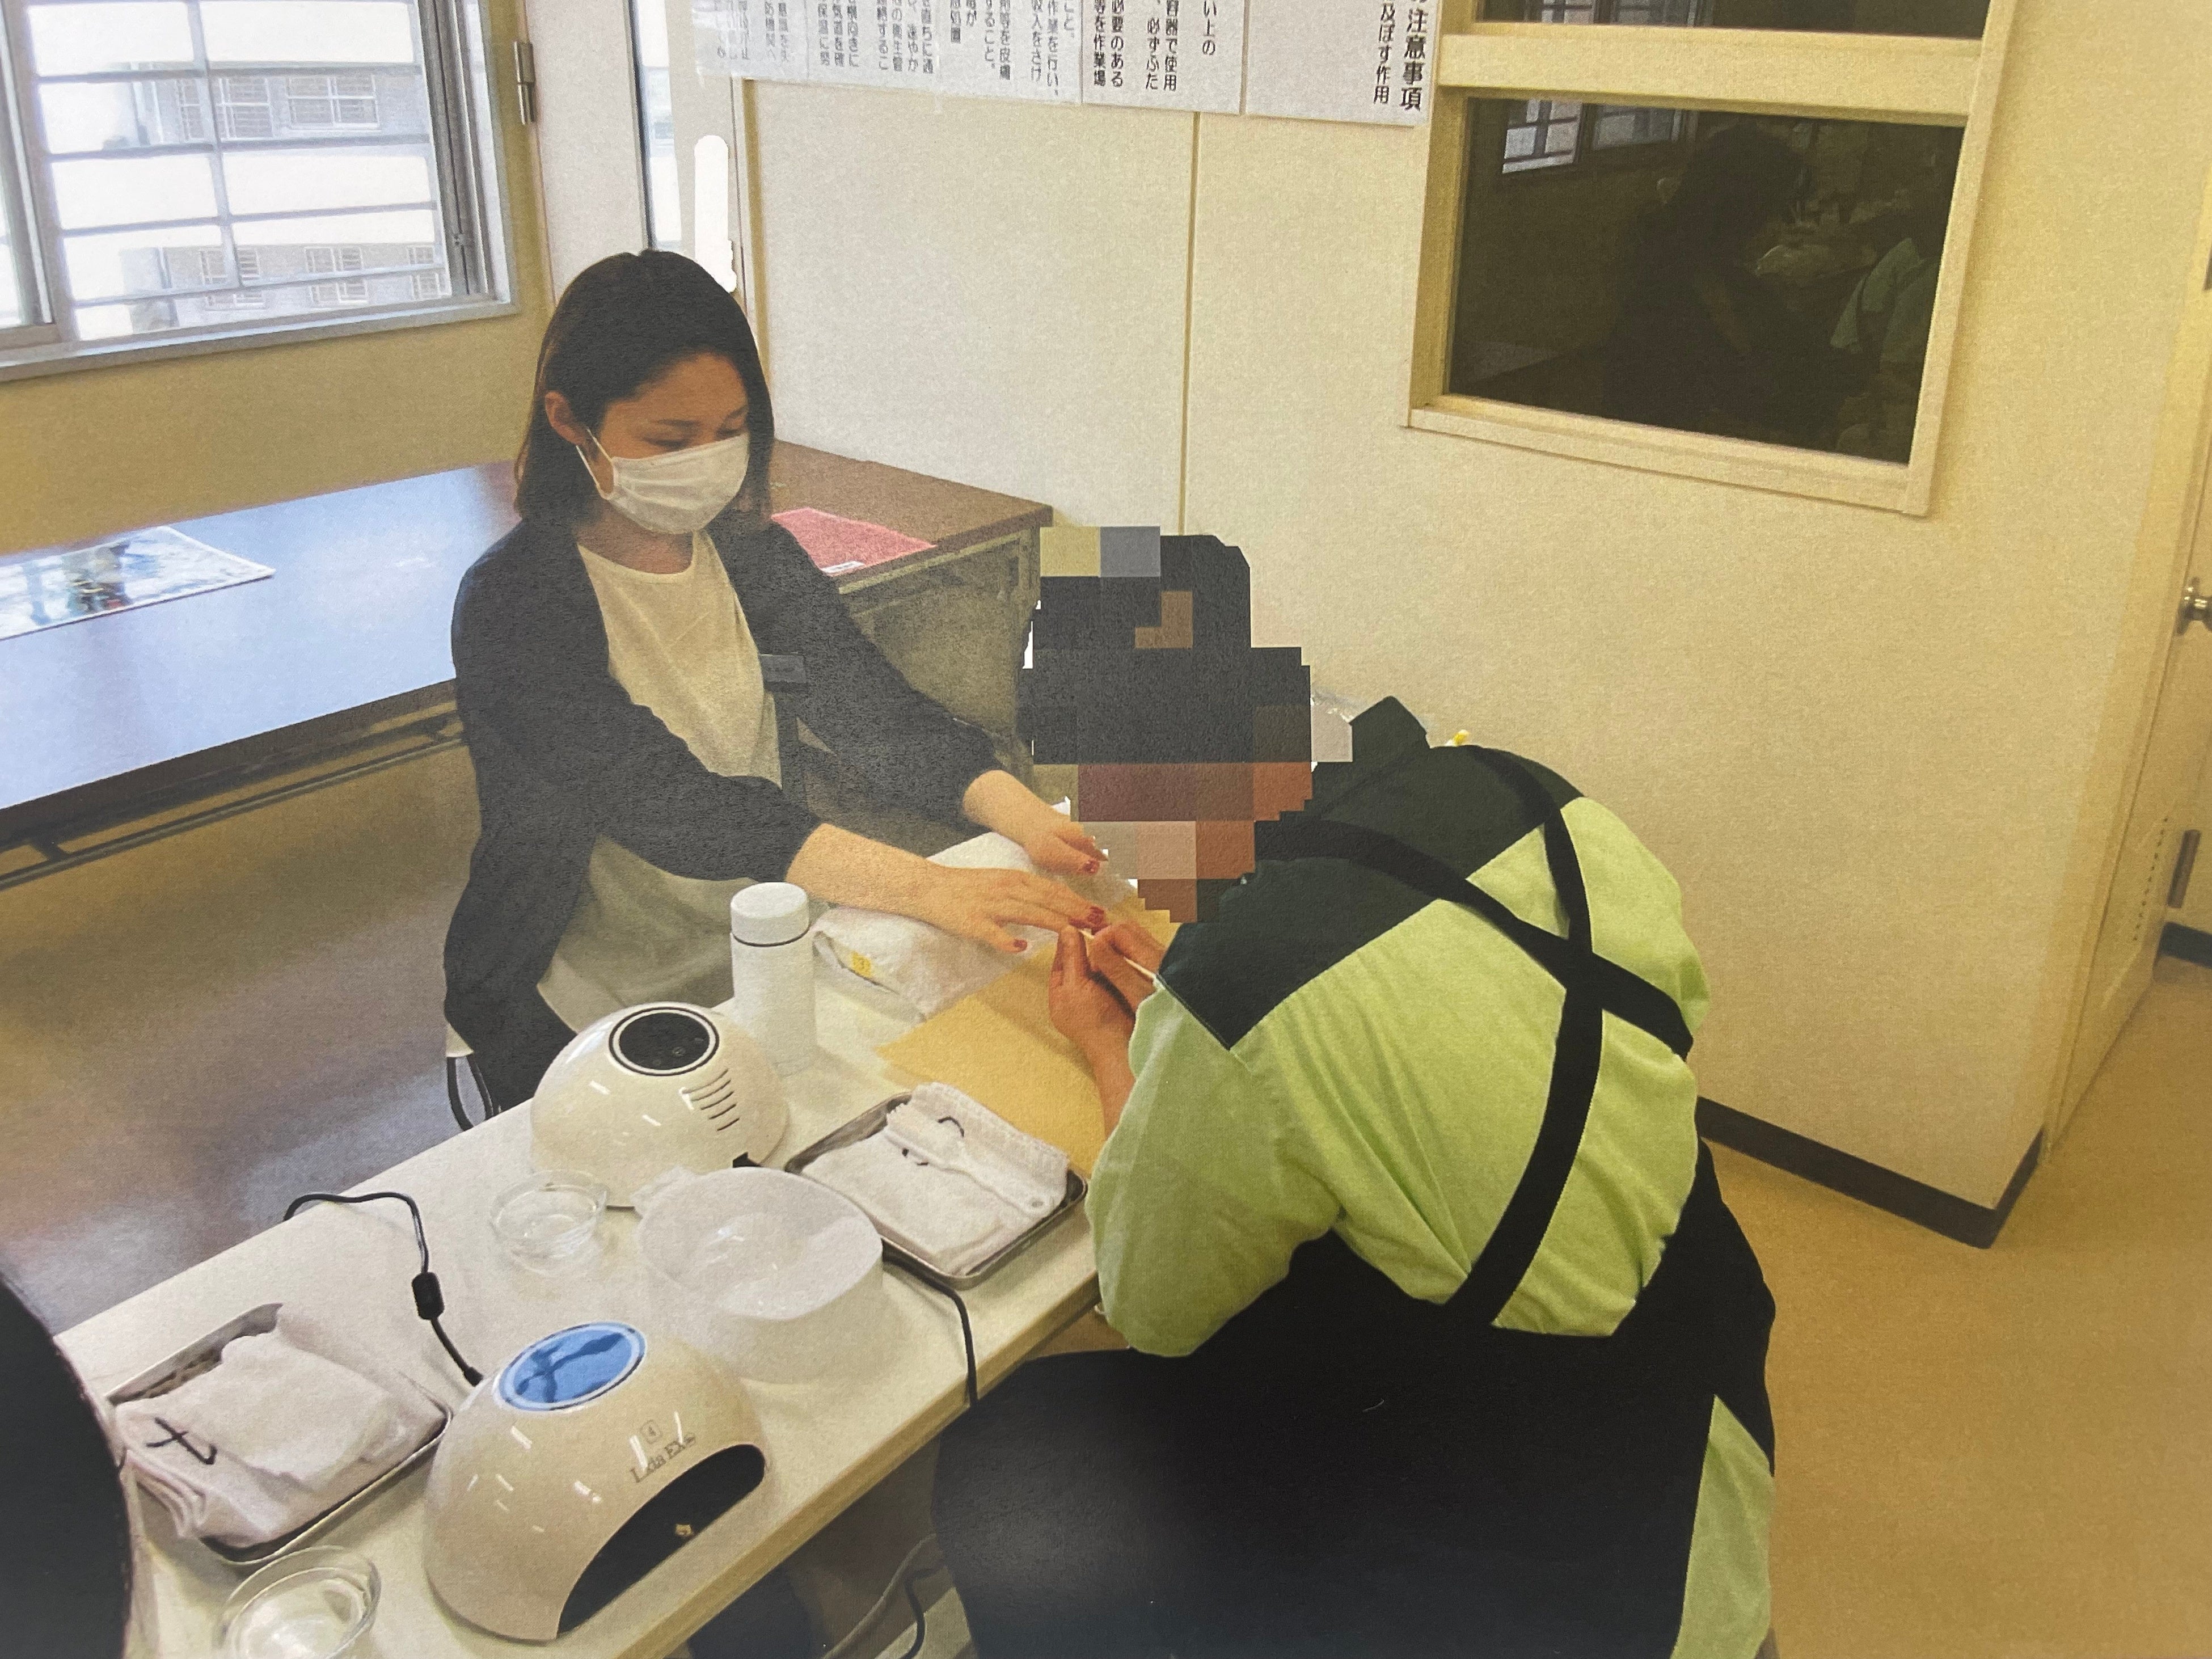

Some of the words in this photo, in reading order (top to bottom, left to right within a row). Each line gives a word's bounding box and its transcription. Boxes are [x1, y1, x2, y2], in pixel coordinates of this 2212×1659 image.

[1373, 0, 1396, 105] 及ぼす作用
[1399, 0, 1430, 112] 注意事項
